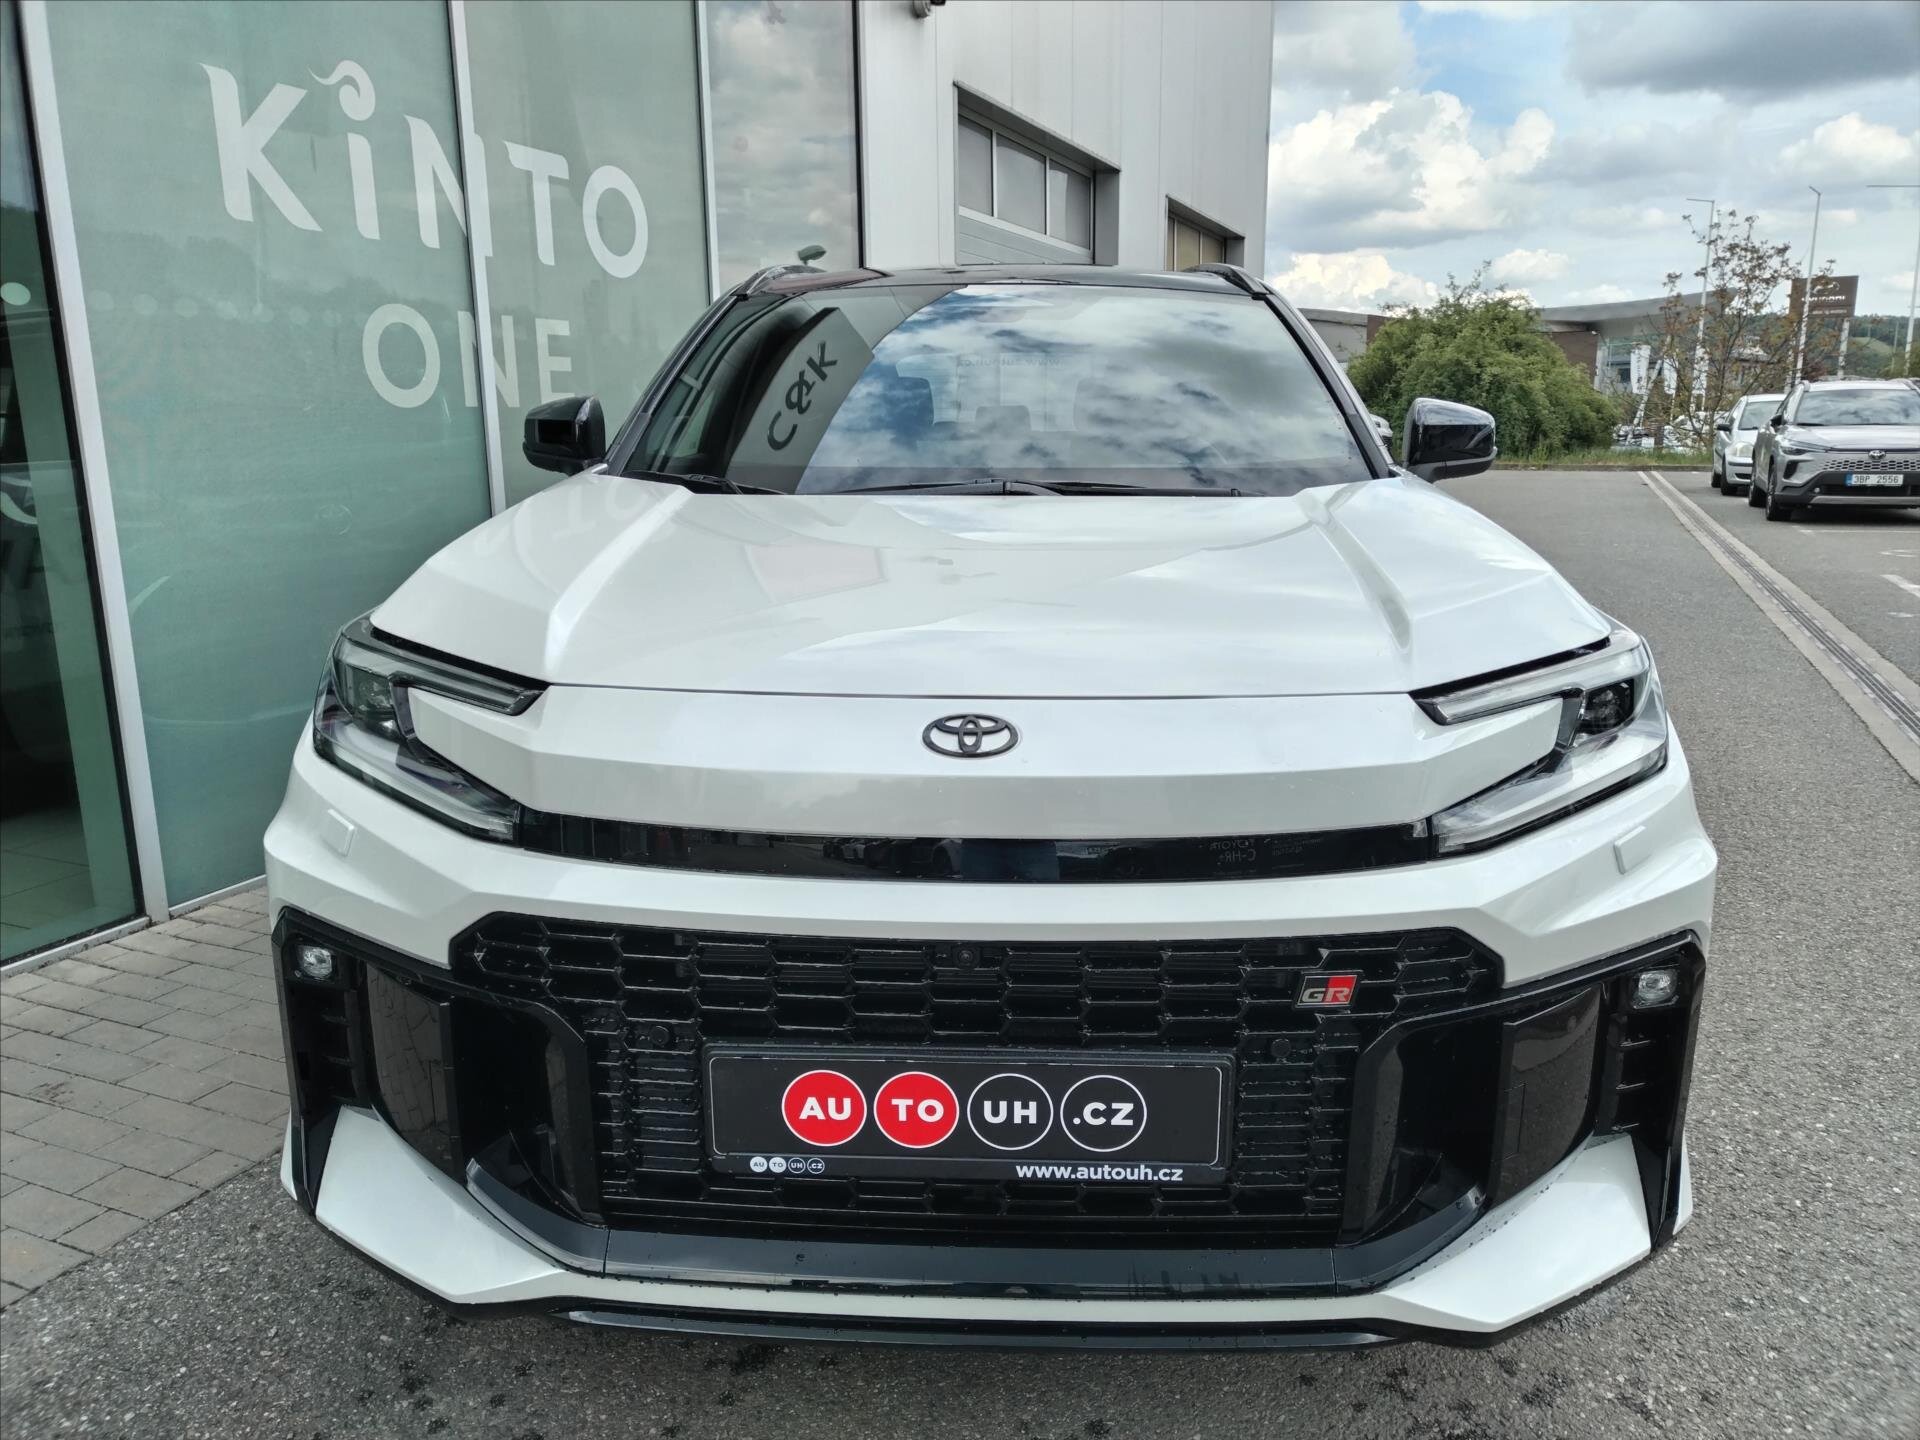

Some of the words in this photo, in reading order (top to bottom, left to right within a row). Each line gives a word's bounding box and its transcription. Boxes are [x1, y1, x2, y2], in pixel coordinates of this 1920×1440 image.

[362, 303, 575, 408] ONE
[1854, 475, 1871, 484] 3BP
[1877, 475, 1899, 484] 2556
[1302, 987, 1350, 1002] GR
[799, 1096, 852, 1121] AU
[891, 1098, 945, 1123] TO
[983, 1100, 1037, 1125] UH
[1072, 1101, 1134, 1126] .CZ
[1015, 1164, 1184, 1182] www.autouh.cz
